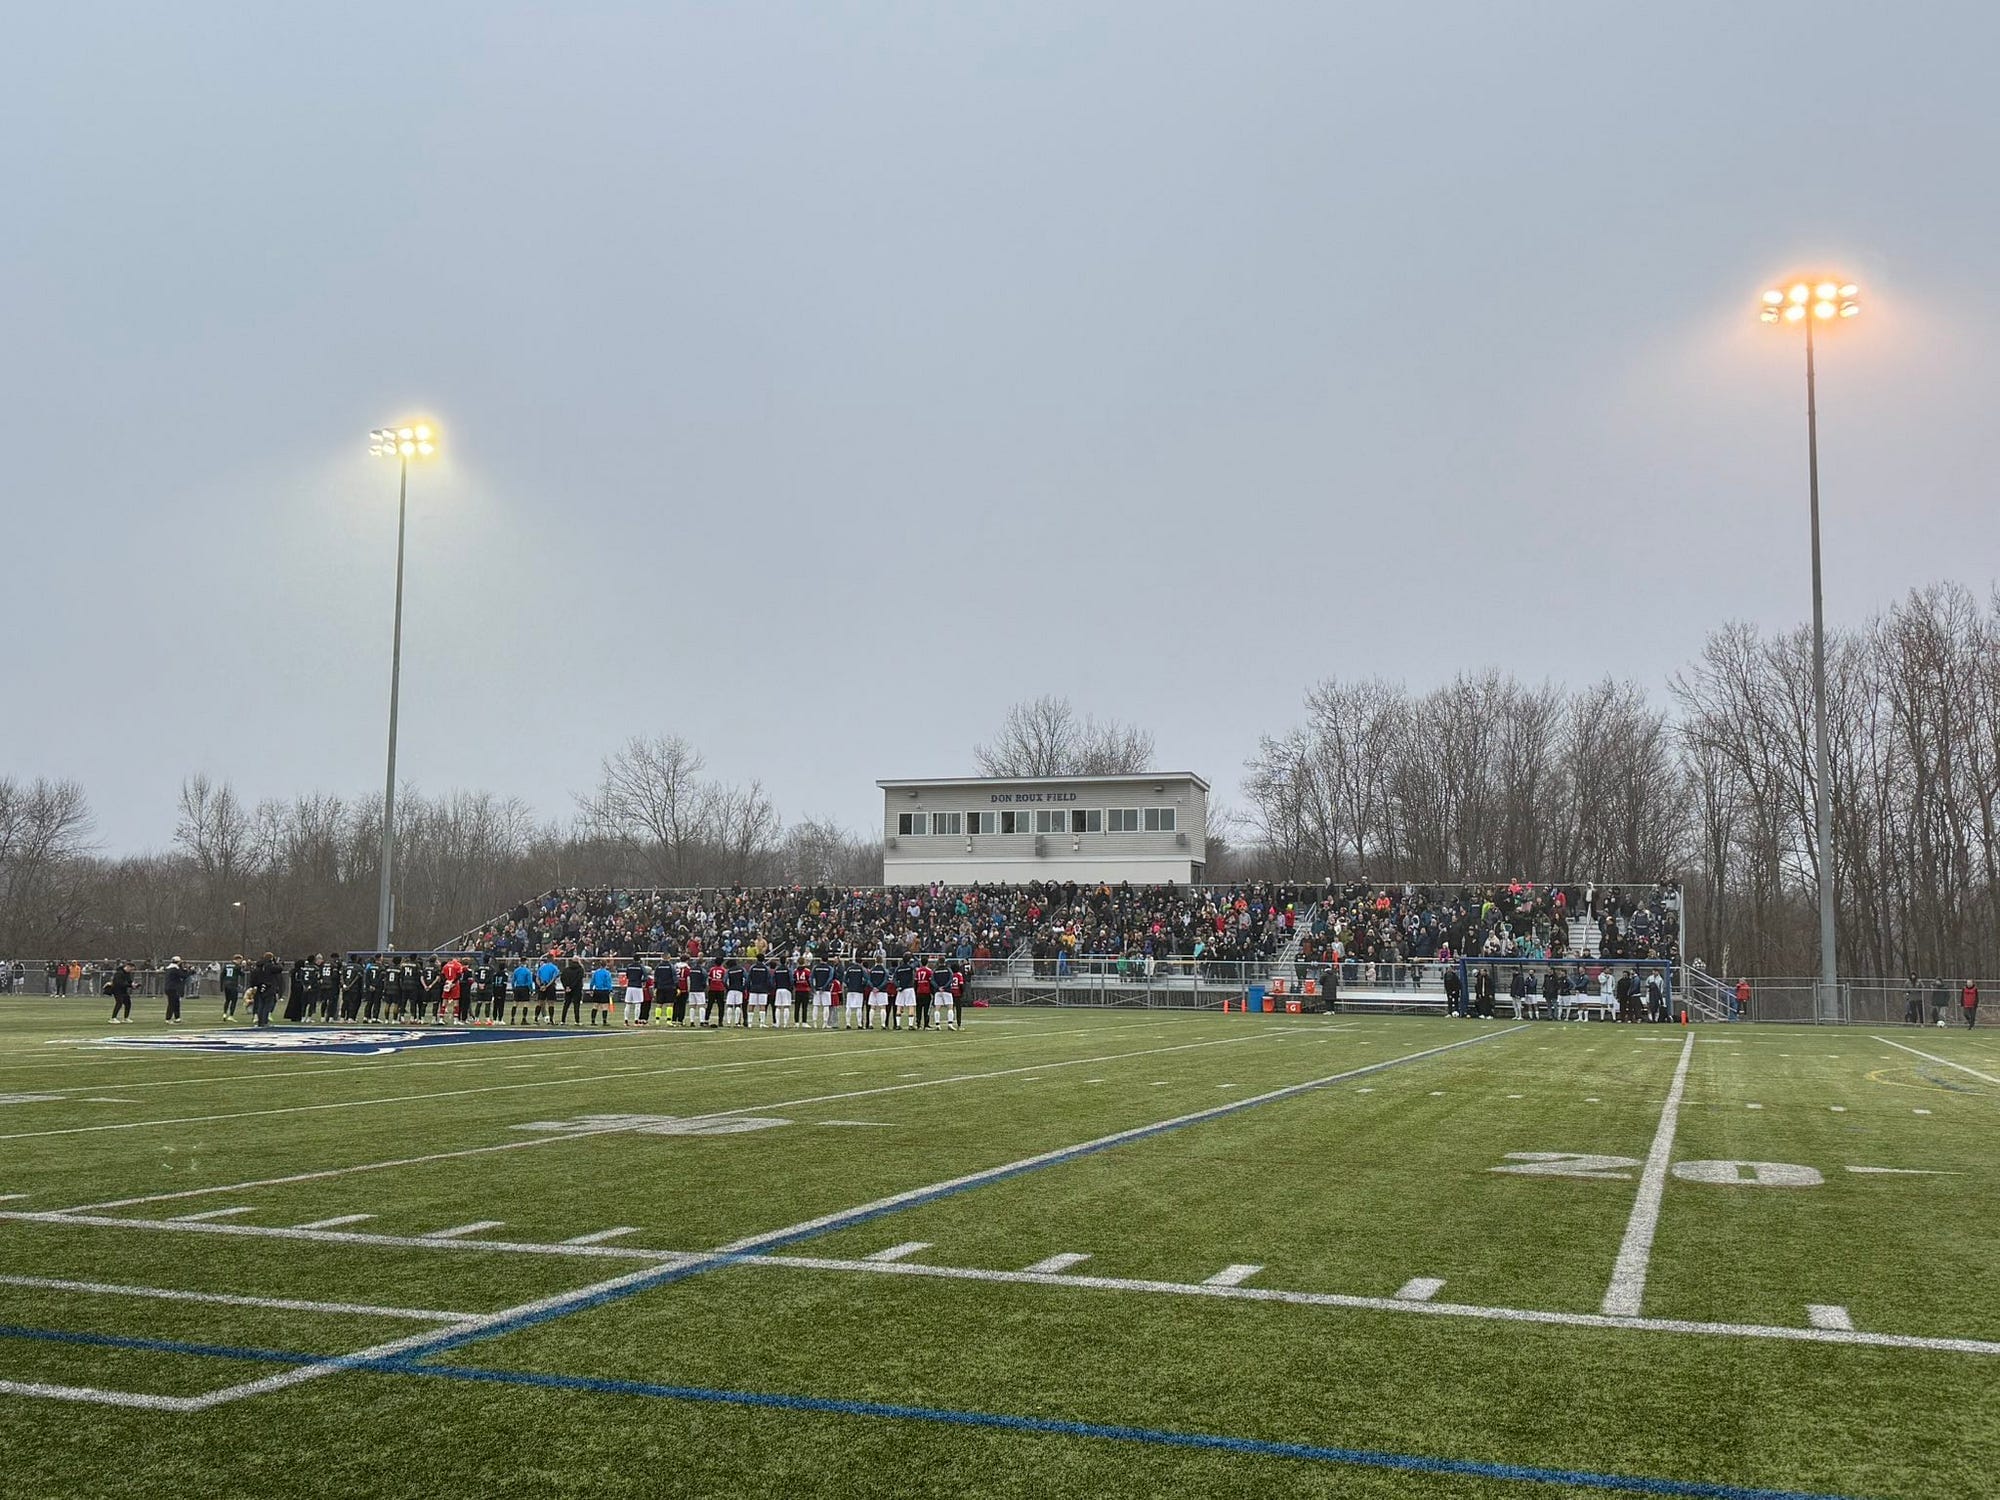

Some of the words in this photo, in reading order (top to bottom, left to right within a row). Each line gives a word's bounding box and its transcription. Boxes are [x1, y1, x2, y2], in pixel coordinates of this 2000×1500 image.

[991, 794, 1012, 802] DON
[1015, 793, 1043, 802] ROUX
[1047, 793, 1077, 801] FIELD
[304, 971, 310, 981] 2
[371, 969, 376, 980] 7
[713, 969, 723, 979] 15
[795, 971, 806, 981] 14
[917, 970, 927, 981] 17
[1488, 1151, 1826, 1186] 20
